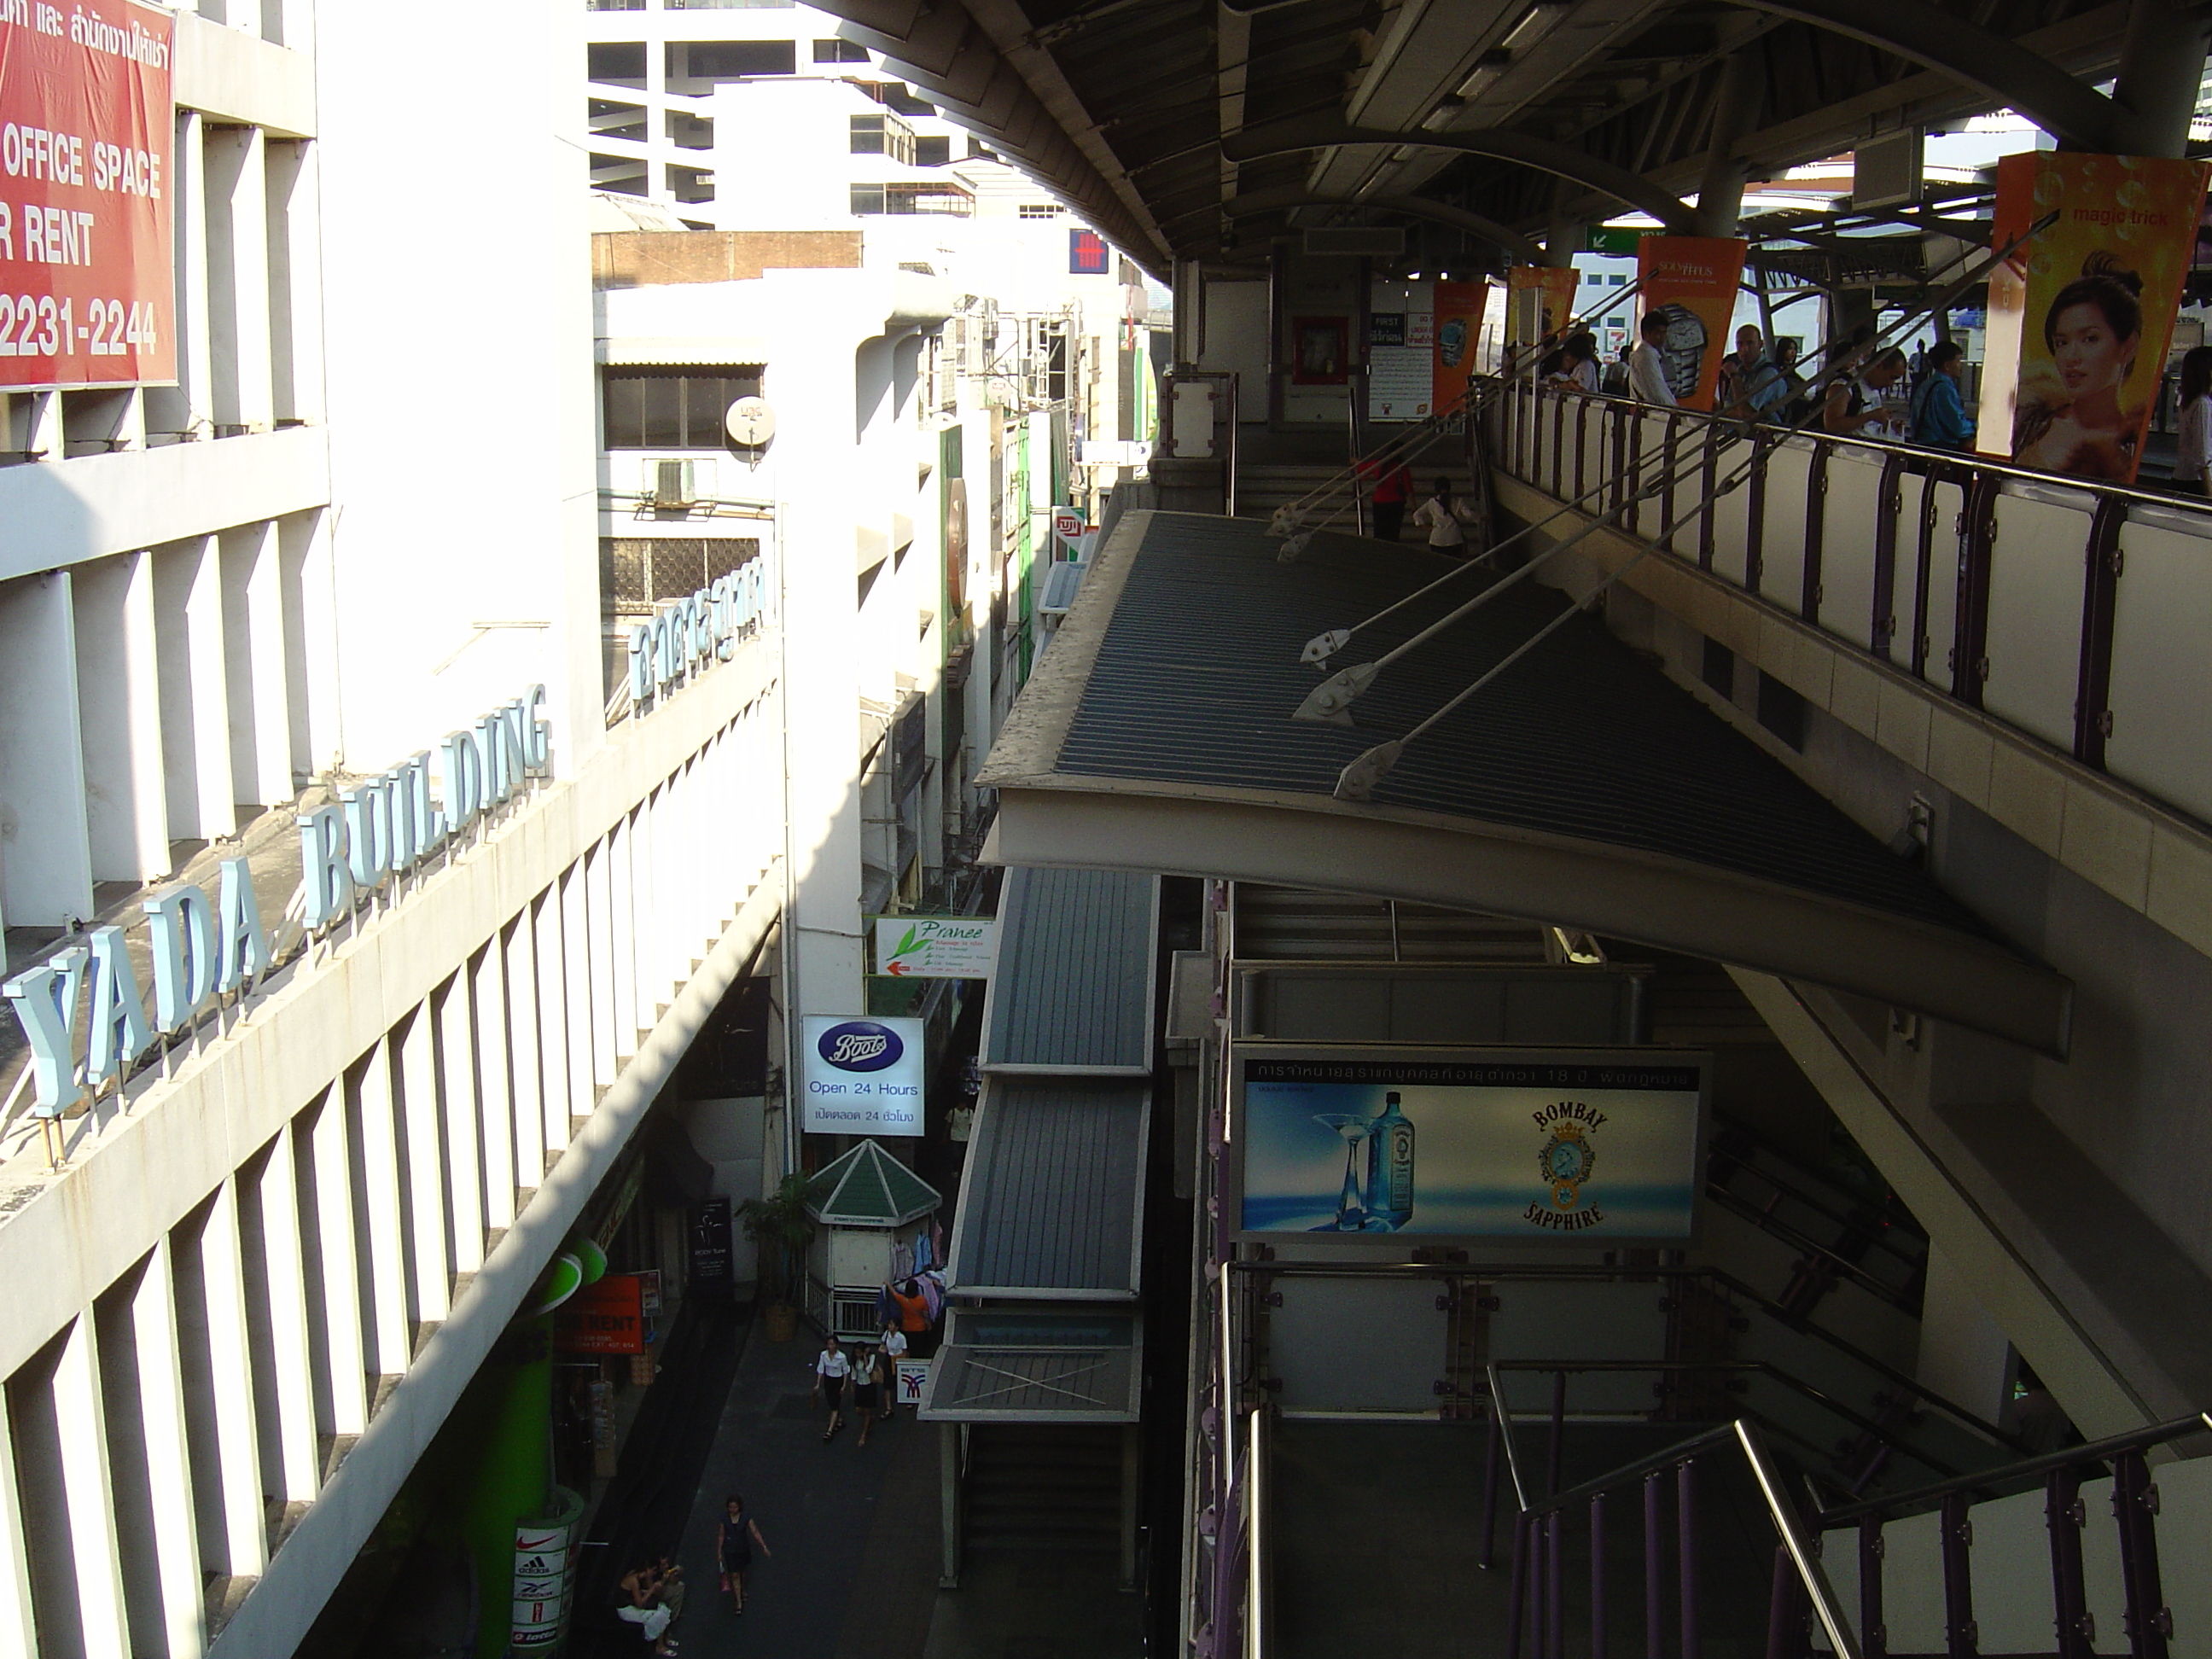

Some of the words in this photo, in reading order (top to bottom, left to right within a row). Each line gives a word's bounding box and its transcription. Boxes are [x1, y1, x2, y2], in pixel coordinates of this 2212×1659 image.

[37, 2, 64, 37] และ
[71, 4, 168, 71] สำนักงานให้เช่า
[3, 122, 83, 187] OFFICE
[94, 141, 160, 199] SPACE
[2073, 207, 2125, 225] magic
[2131, 209, 2168, 224] trick
[25, 205, 94, 266] RENT
[0, 294, 156, 356] 2231-2244
[1375, 317, 1398, 326] FIRST
[629, 556, 766, 701] อาคารญาดา
[2, 856, 271, 1119] YADA
[297, 684, 551, 928] BUILDING
[921, 920, 983, 939] Pranee
[829, 1033, 888, 1063] Boots
[810, 1080, 847, 1096] Open
[854, 1083, 870, 1094] 24
[879, 1083, 918, 1096] Hours
[1548, 1069, 1568, 1082] 18
[815, 1107, 860, 1121] เปิดตลอด
[866, 1111, 879, 1121] 24
[883, 1109, 914, 1122] ชั่วโมง
[1532, 1102, 1608, 1132] BOMBAY
[1523, 1200, 1604, 1231] SAPPHIRE
[589, 1315, 636, 1331] RENT
[526, 1630, 556, 1641] lotto
